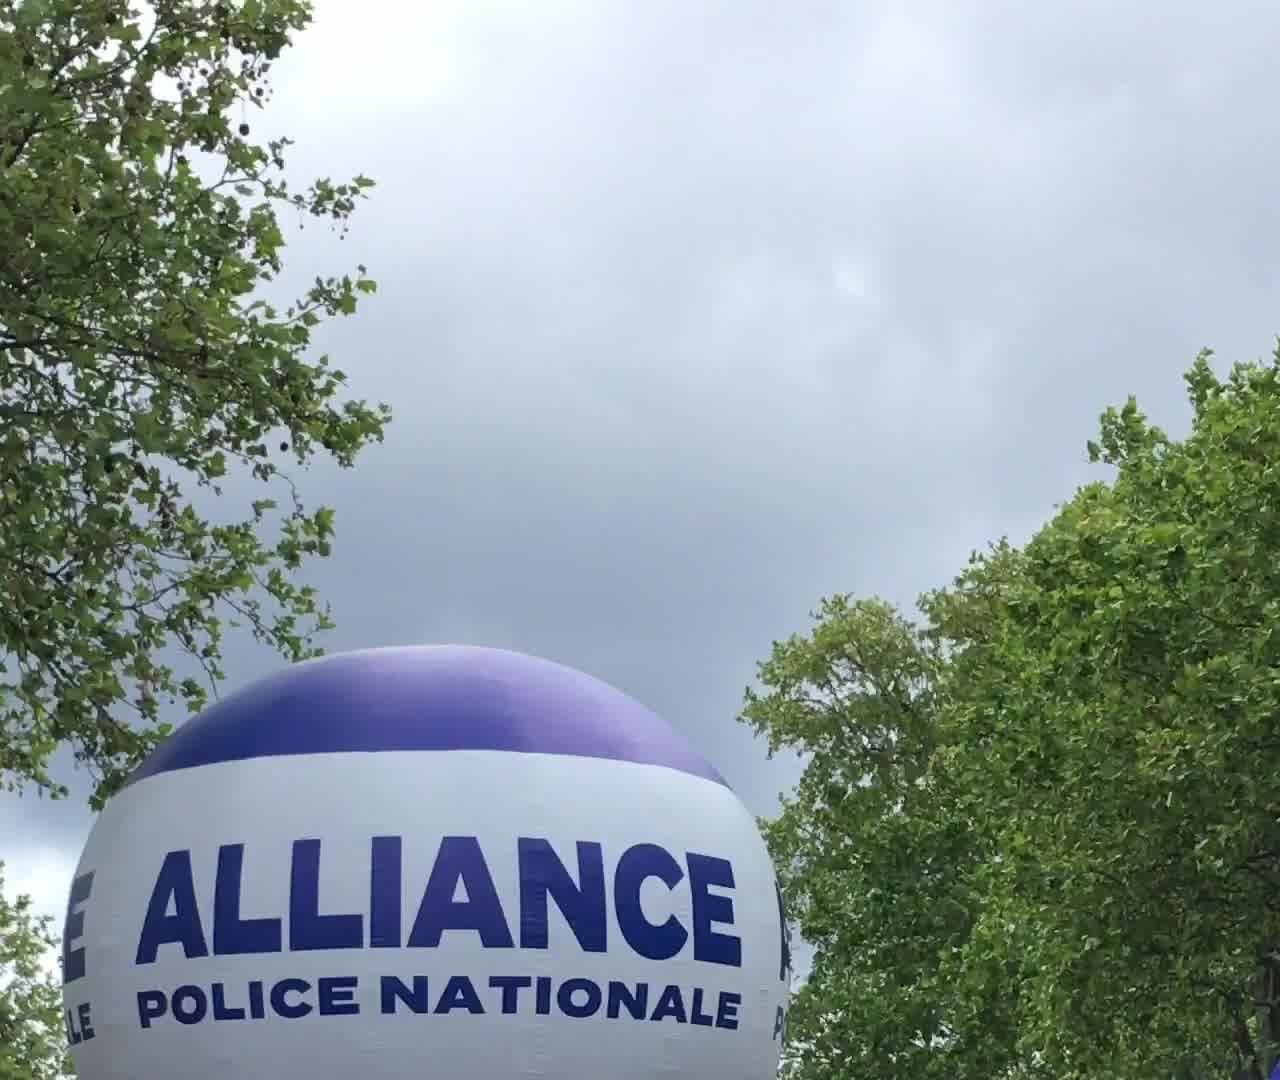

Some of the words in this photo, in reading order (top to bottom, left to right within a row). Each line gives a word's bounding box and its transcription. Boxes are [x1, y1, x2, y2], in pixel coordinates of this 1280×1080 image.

[135, 836, 742, 967] ALLIANCE
[137, 976, 359, 1029] POLICE
[380, 975, 741, 1030] NATIONALE
